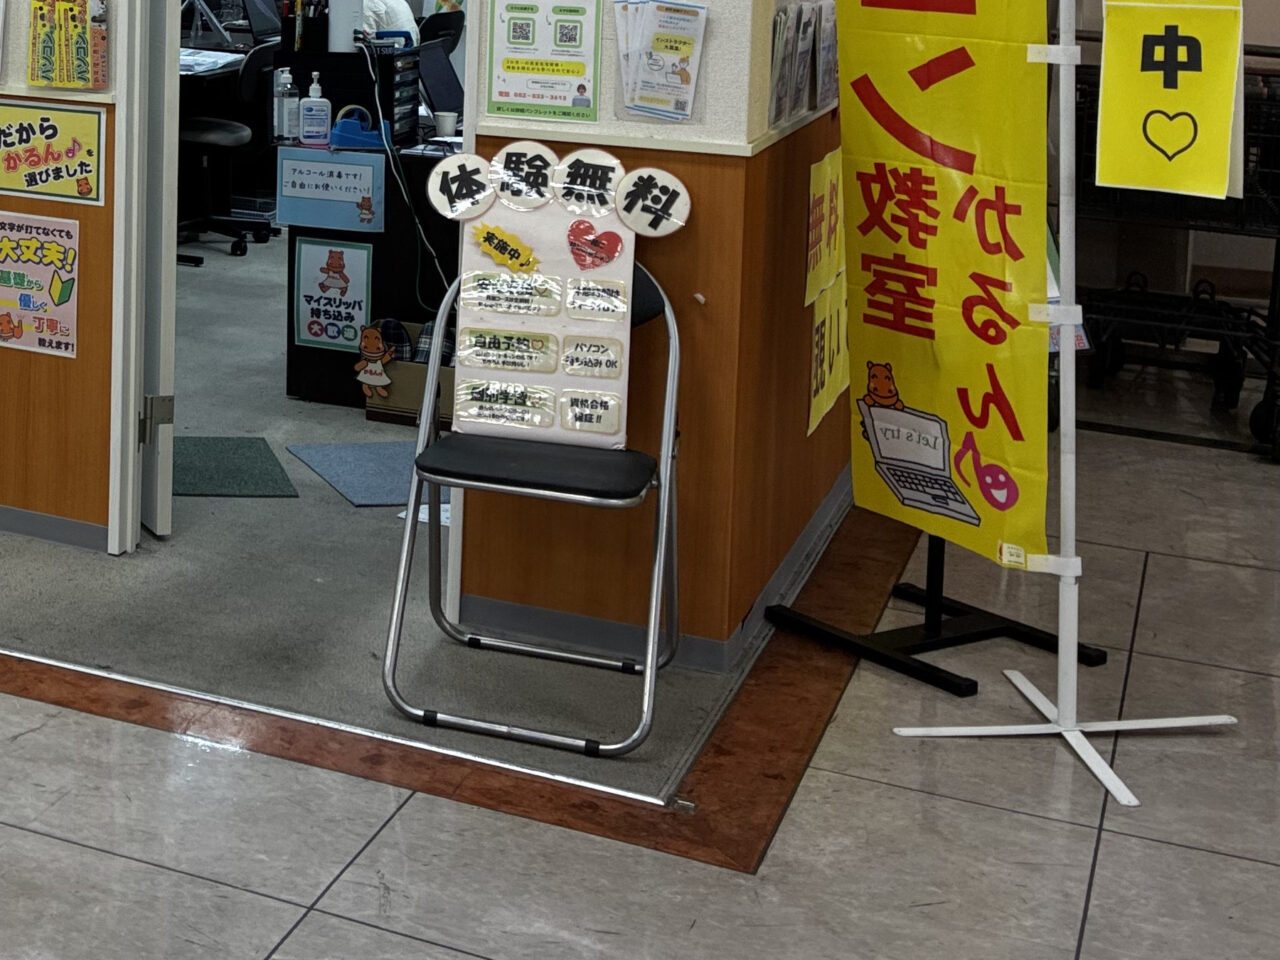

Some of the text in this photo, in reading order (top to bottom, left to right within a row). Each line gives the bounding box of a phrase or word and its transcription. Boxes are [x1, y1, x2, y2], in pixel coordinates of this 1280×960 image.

[2, 141, 63, 174] かるん
[24, 159, 93, 189] 選びました
[291, 168, 363, 181] アルコール消毒です!
[283, 180, 370, 195] ご自由にお使いください!
[439, 152, 681, 231] 体験無料
[482, 231, 522, 262] 実施中
[18, 292, 48, 313] 優しく
[303, 293, 364, 312] マイスリッパ
[309, 307, 357, 324] 持ち込み
[32, 315, 71, 337] 丁寧に
[37, 337, 75, 353] 教えます!
[574, 342, 610, 354] パソコン
[605, 359, 618, 369] OK
